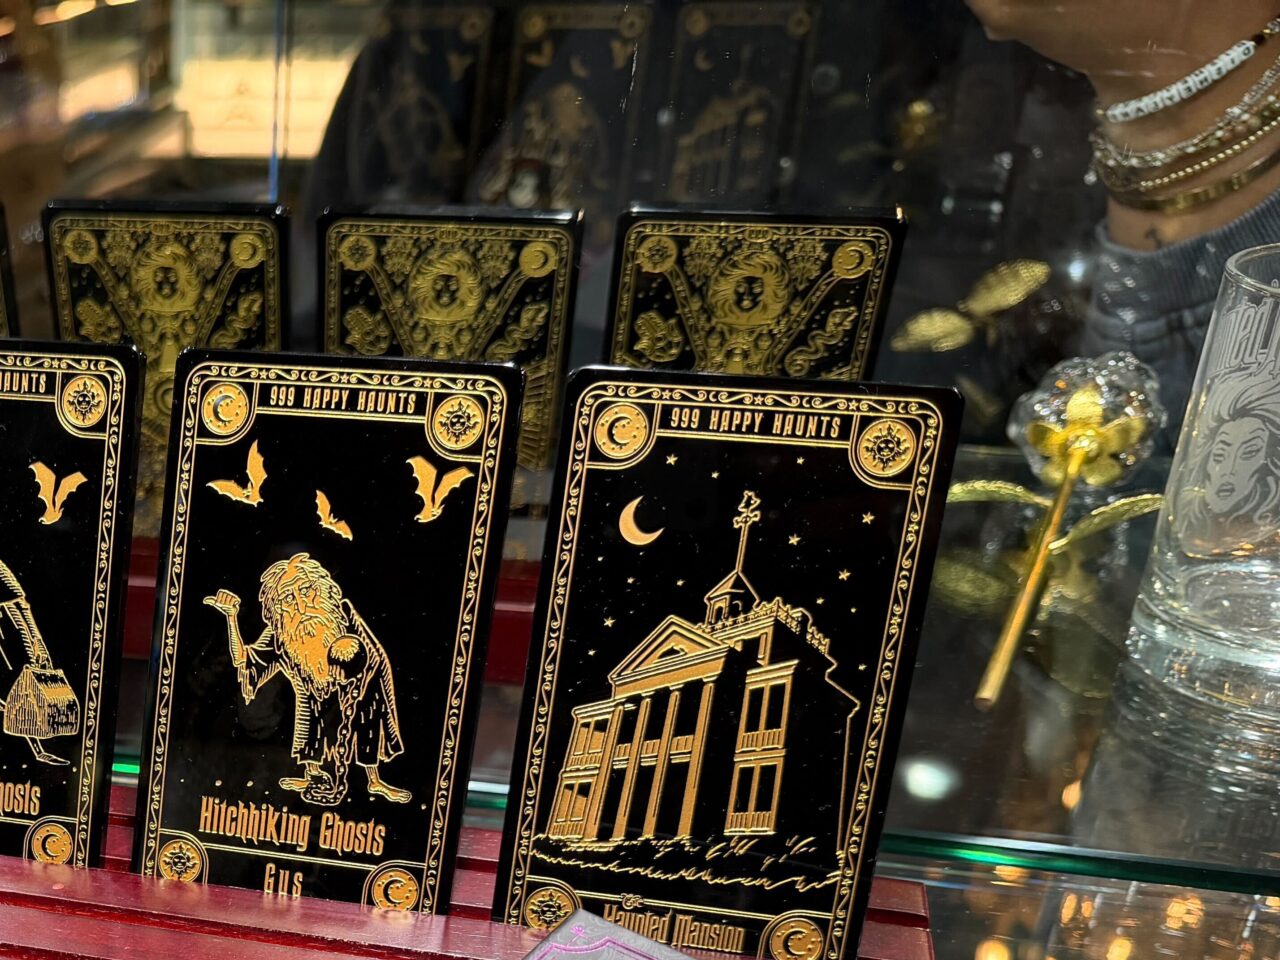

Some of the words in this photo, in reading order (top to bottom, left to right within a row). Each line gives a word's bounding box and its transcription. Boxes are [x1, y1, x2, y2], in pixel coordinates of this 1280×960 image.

[270, 385, 295, 407] 999
[302, 387, 350, 410] HAPPY
[357, 390, 417, 415] HAUNTS
[670, 407, 700, 429] 999
[708, 409, 764, 433] HAPPY
[772, 412, 841, 438] HAUNTS
[198, 795, 311, 852] Hitchhiking
[318, 810, 386, 856] Ghosts
[263, 862, 304, 897] Gus
[671, 914, 745, 954] Mansion
